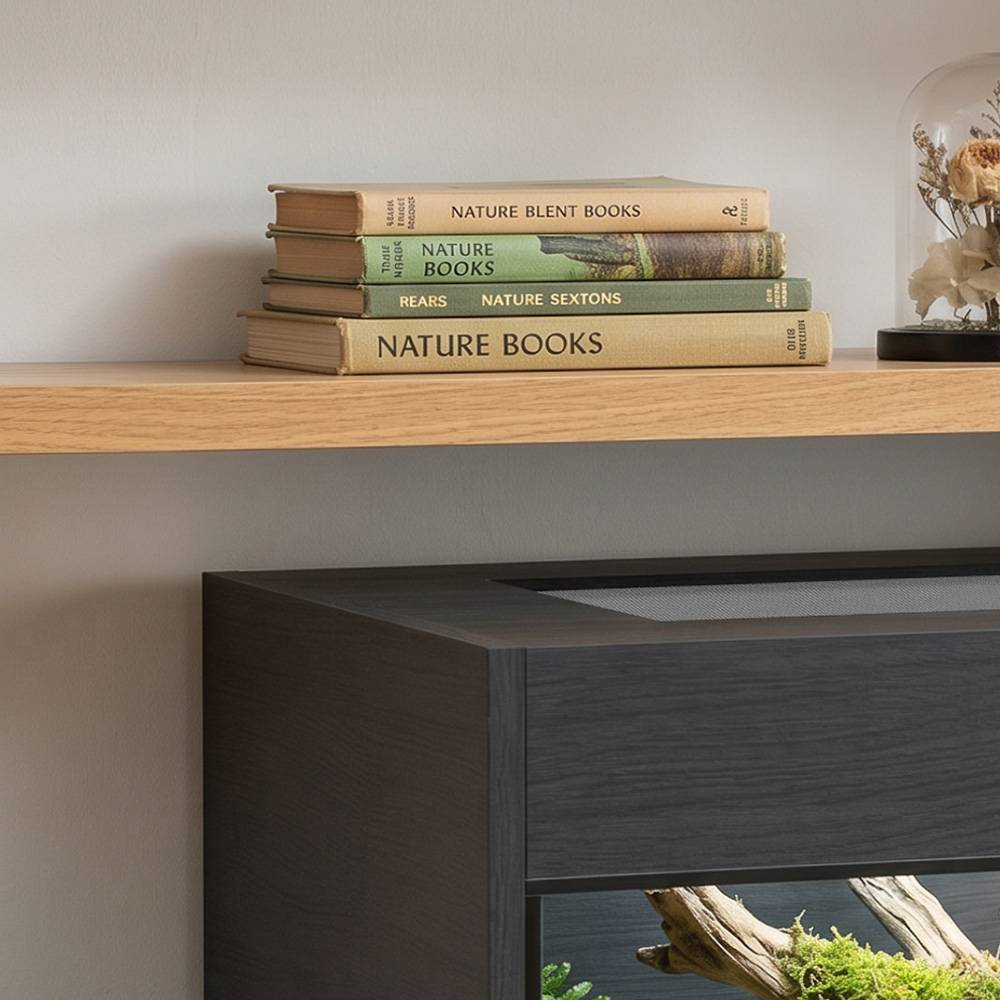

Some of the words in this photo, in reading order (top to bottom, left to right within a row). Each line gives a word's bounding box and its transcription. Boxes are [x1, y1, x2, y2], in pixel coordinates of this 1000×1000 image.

[450, 205, 519, 219] NATURE
[525, 205, 579, 219] BLENT
[584, 204, 642, 218] BOOKS
[421, 242, 494, 257] NATURE
[423, 260, 495, 277] BOOKS
[399, 295, 448, 308] REARS
[481, 293, 545, 306] NATURE
[550, 292, 622, 306] SEXTONS
[377, 333, 490, 357] NATURE
[503, 331, 603, 355] BOOKS
